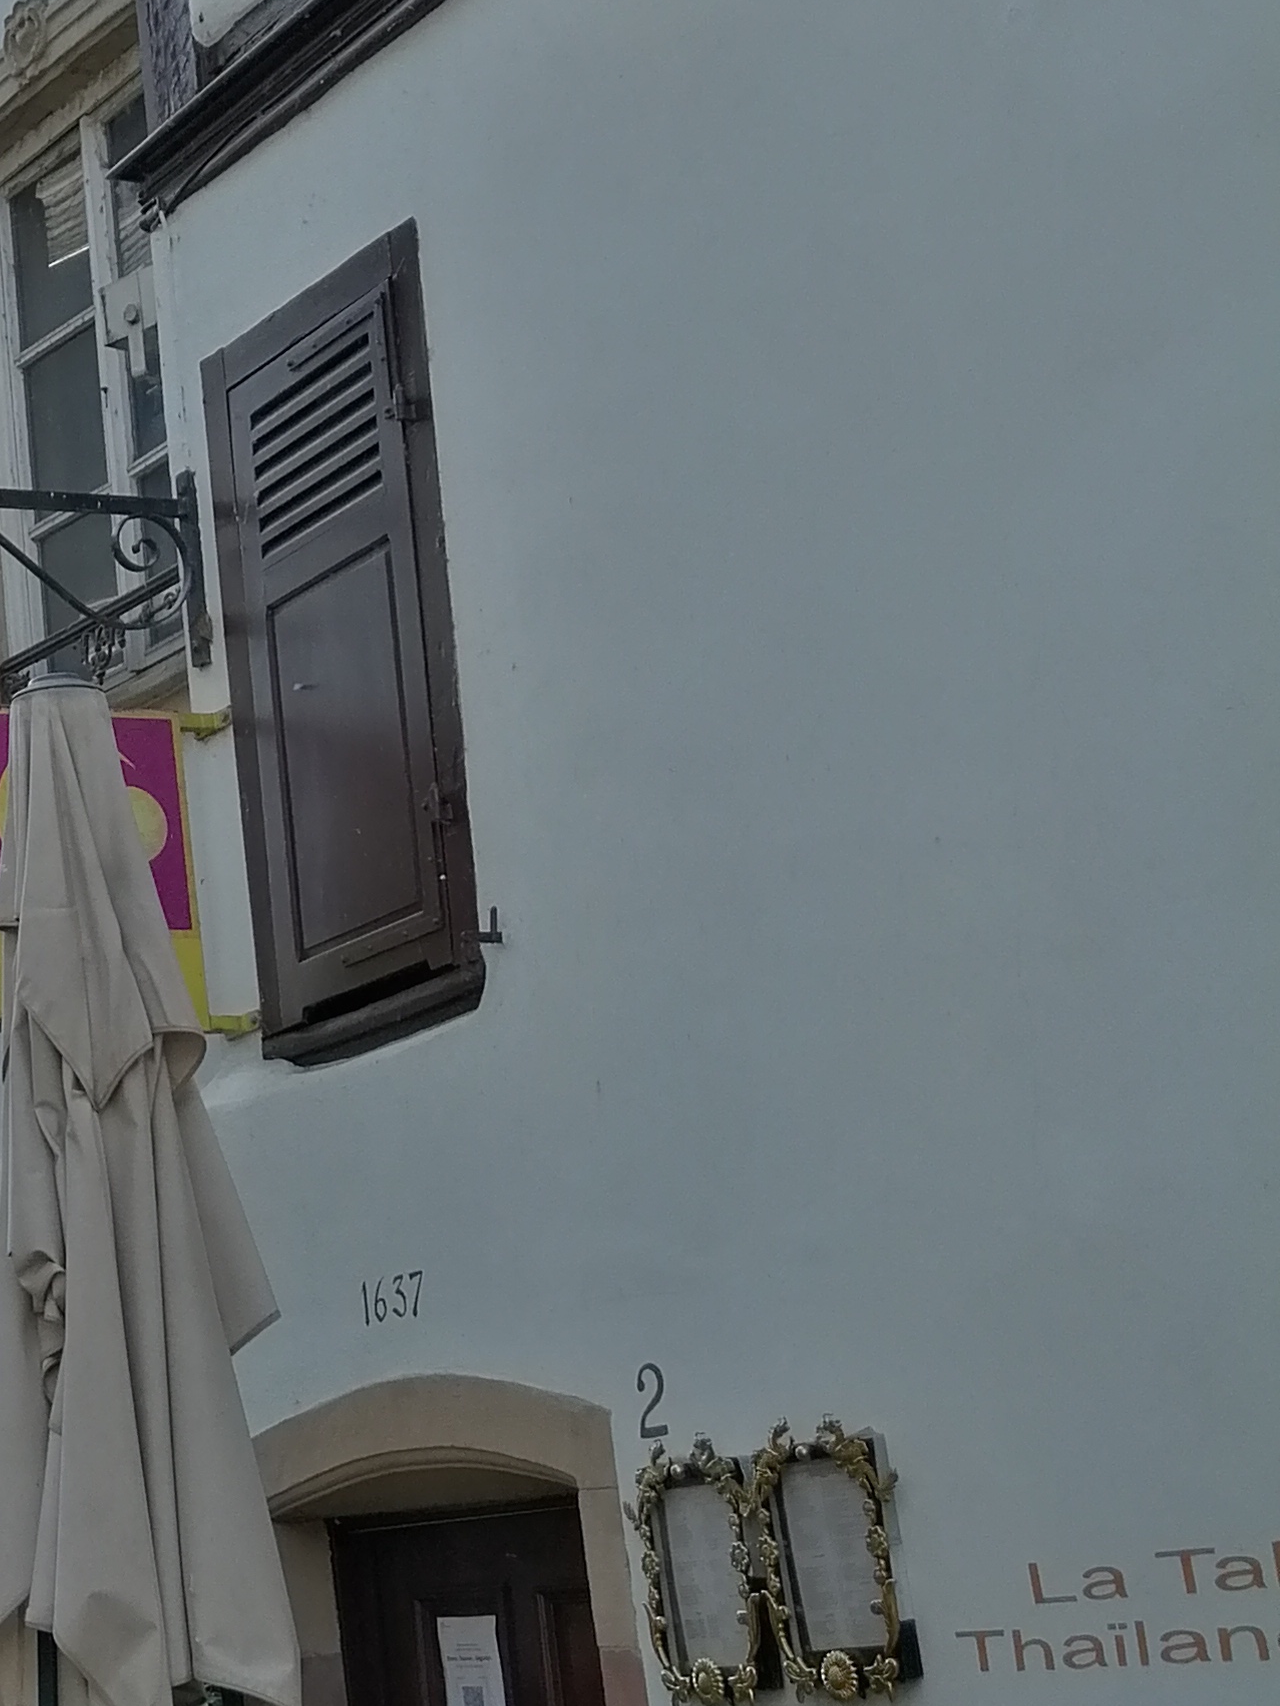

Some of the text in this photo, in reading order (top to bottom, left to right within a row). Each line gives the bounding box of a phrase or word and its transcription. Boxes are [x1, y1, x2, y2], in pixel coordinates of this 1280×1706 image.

[362, 1270, 423, 1327] 1637
[637, 1362, 669, 1439] 2
[1028, 1541, 1280, 1604] La Ta
[955, 1620, 1280, 1672] Thaïlan
